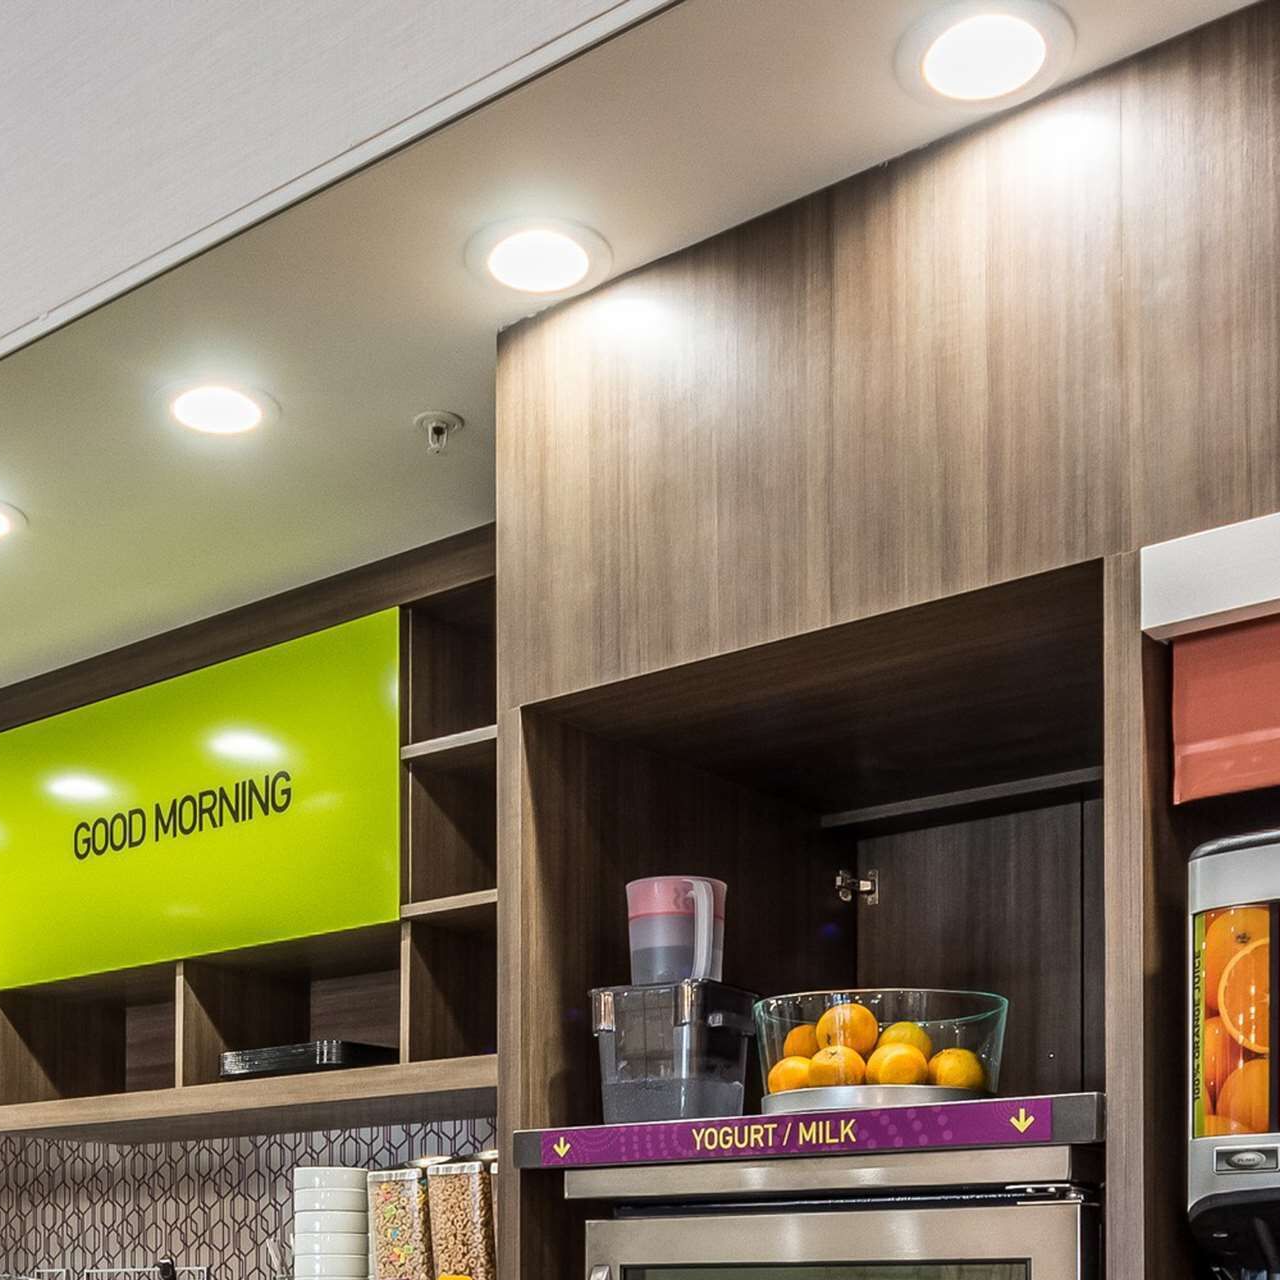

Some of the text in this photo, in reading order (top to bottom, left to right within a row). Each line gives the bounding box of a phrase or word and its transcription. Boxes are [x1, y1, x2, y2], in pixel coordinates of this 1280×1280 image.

[74, 771, 293, 861] GOOD MORNING
[1193, 950, 1201, 992] JUICE
[1193, 998, 1201, 1060] ORANGE
[691, 1118, 857, 1151] YOGURT / MILK
